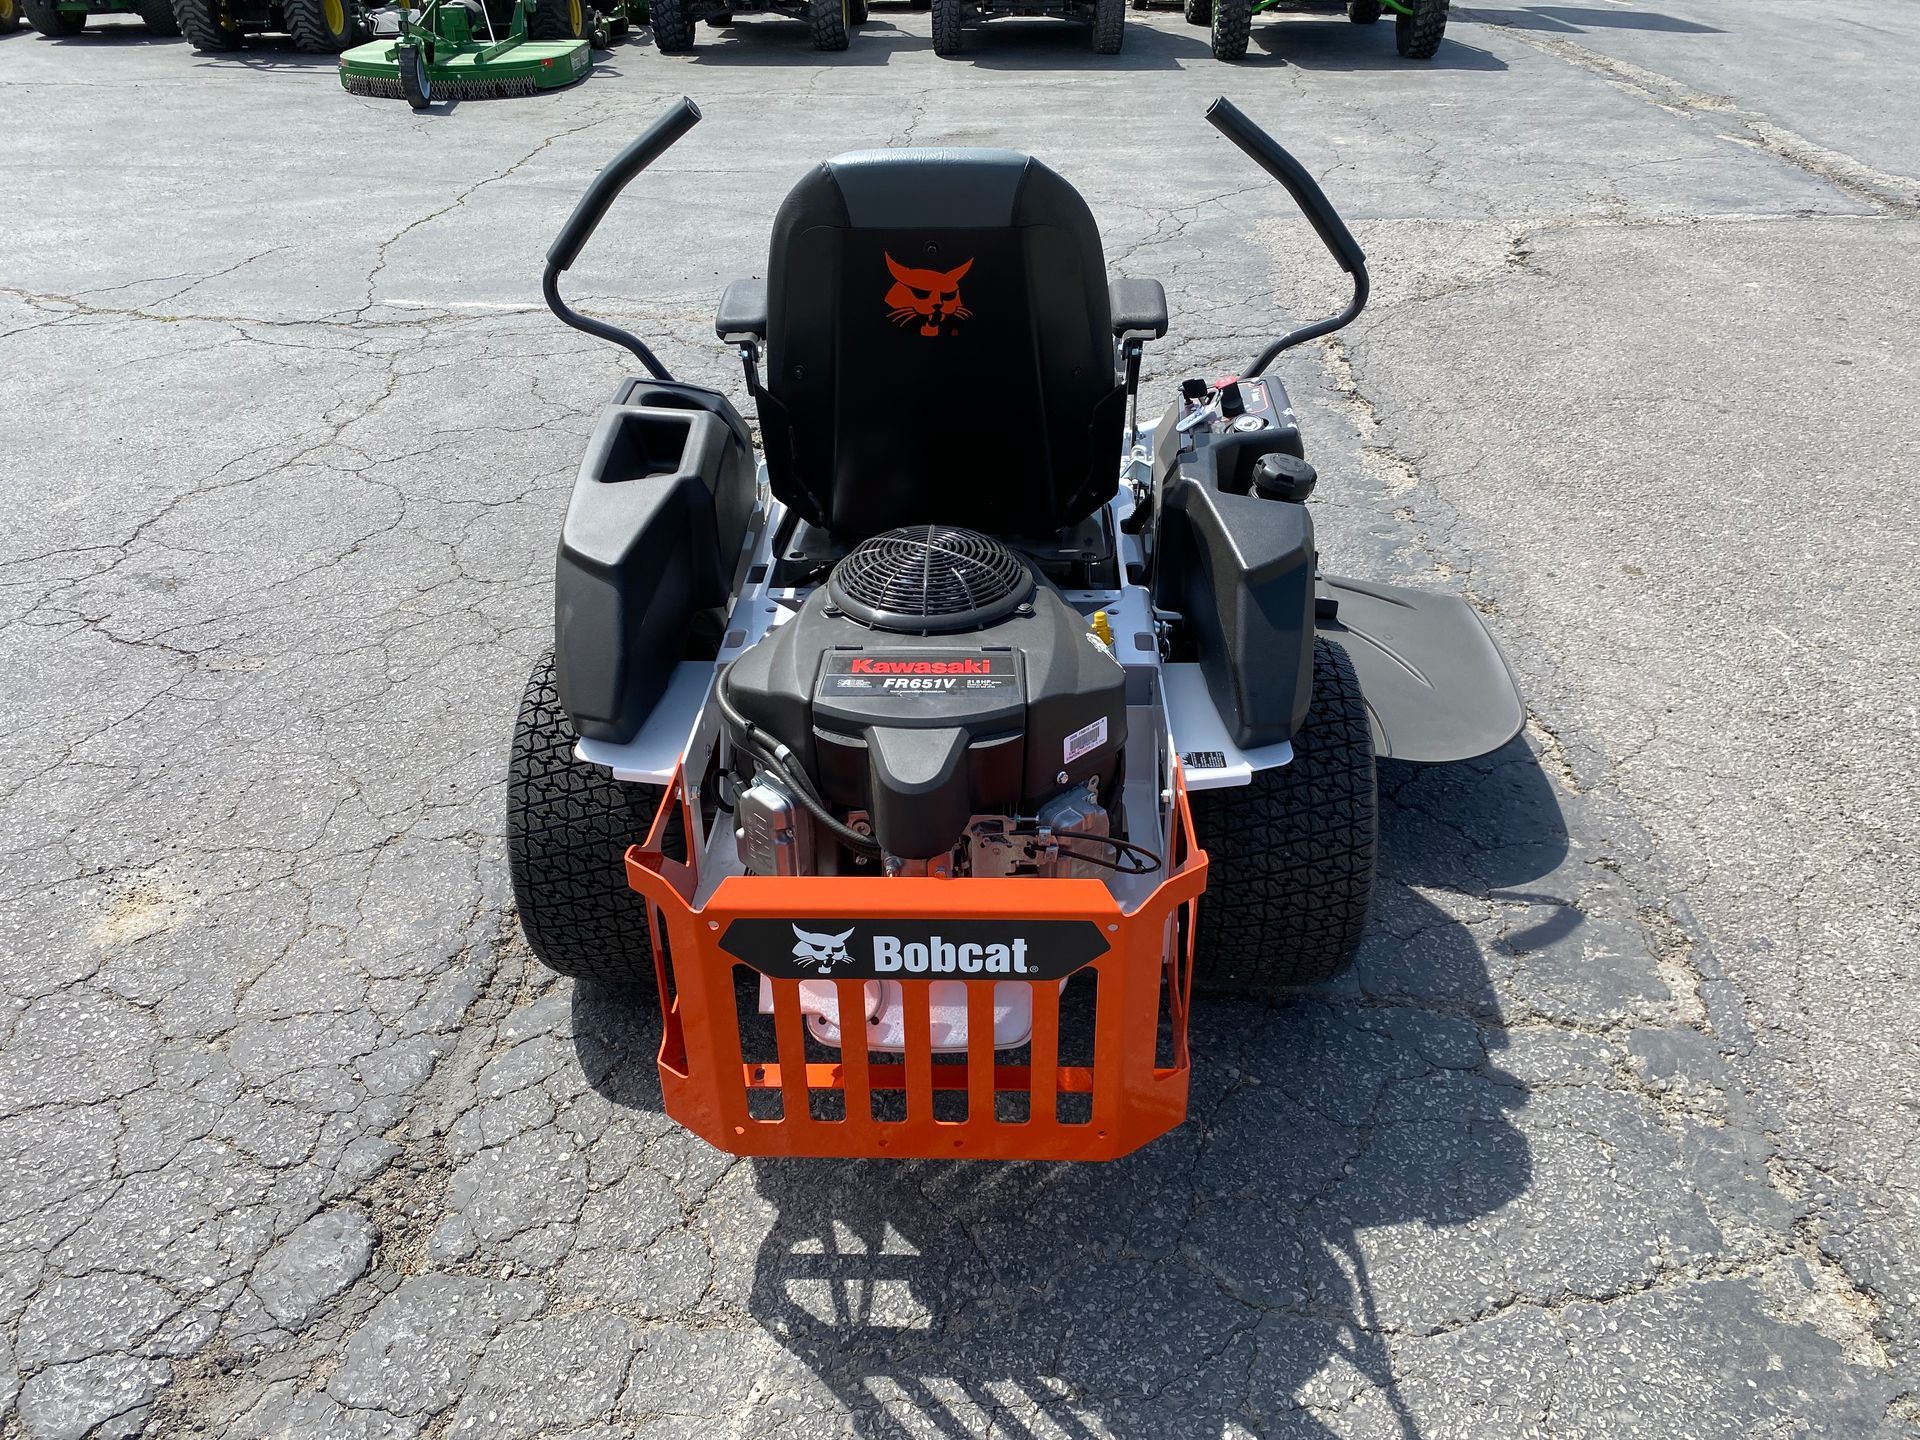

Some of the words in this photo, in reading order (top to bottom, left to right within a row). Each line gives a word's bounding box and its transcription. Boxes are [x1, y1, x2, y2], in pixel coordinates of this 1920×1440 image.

[851, 658, 991, 674] Kawasaki
[883, 678, 957, 689] FR651V
[873, 936, 1028, 973] Bobcat
